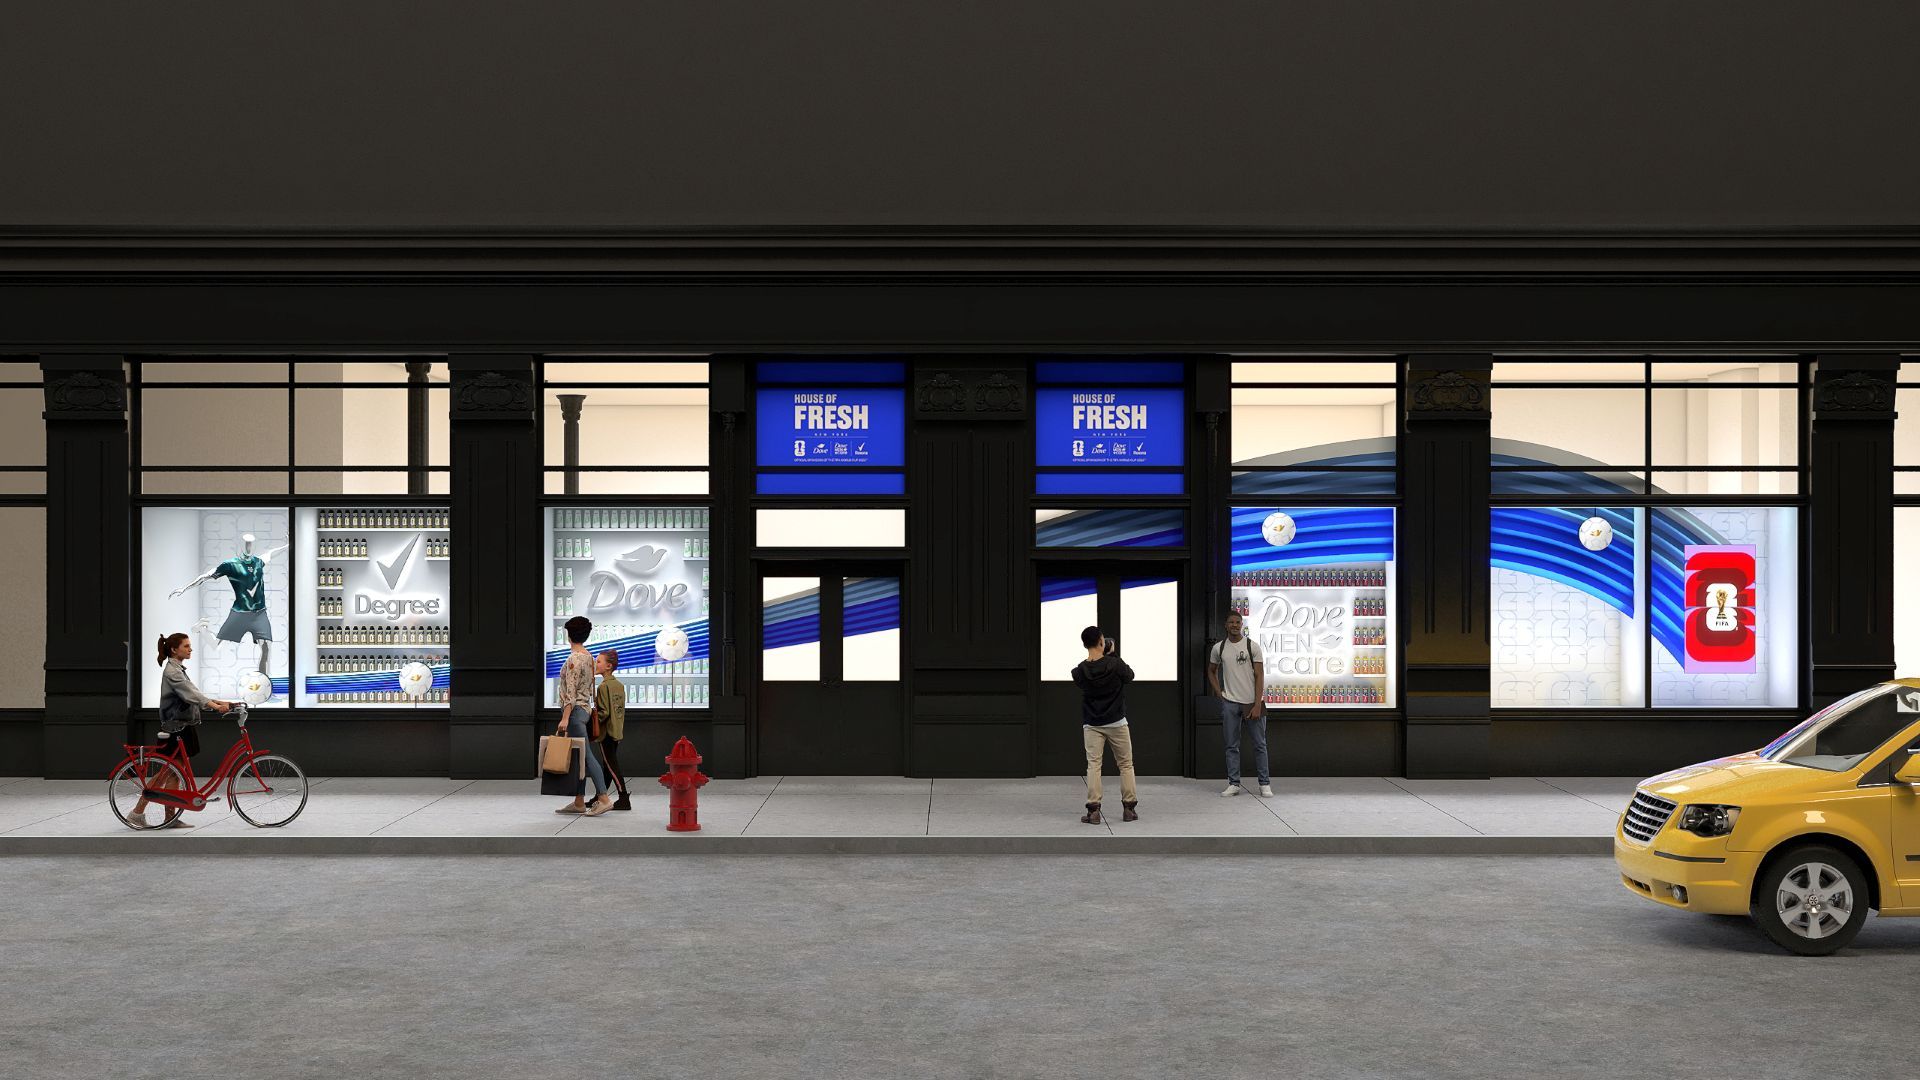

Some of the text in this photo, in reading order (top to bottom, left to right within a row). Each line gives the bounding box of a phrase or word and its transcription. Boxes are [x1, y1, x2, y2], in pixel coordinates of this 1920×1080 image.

[794, 394, 838, 404] HOUSE OF
[1073, 394, 1116, 404] HOUSE OF
[794, 405, 869, 430] FRESH
[1073, 405, 1147, 430] FRESH
[587, 570, 688, 609] Dove
[354, 594, 440, 620] Degree
[1260, 595, 1345, 629] Dove
[1259, 633, 1313, 653] MEN
